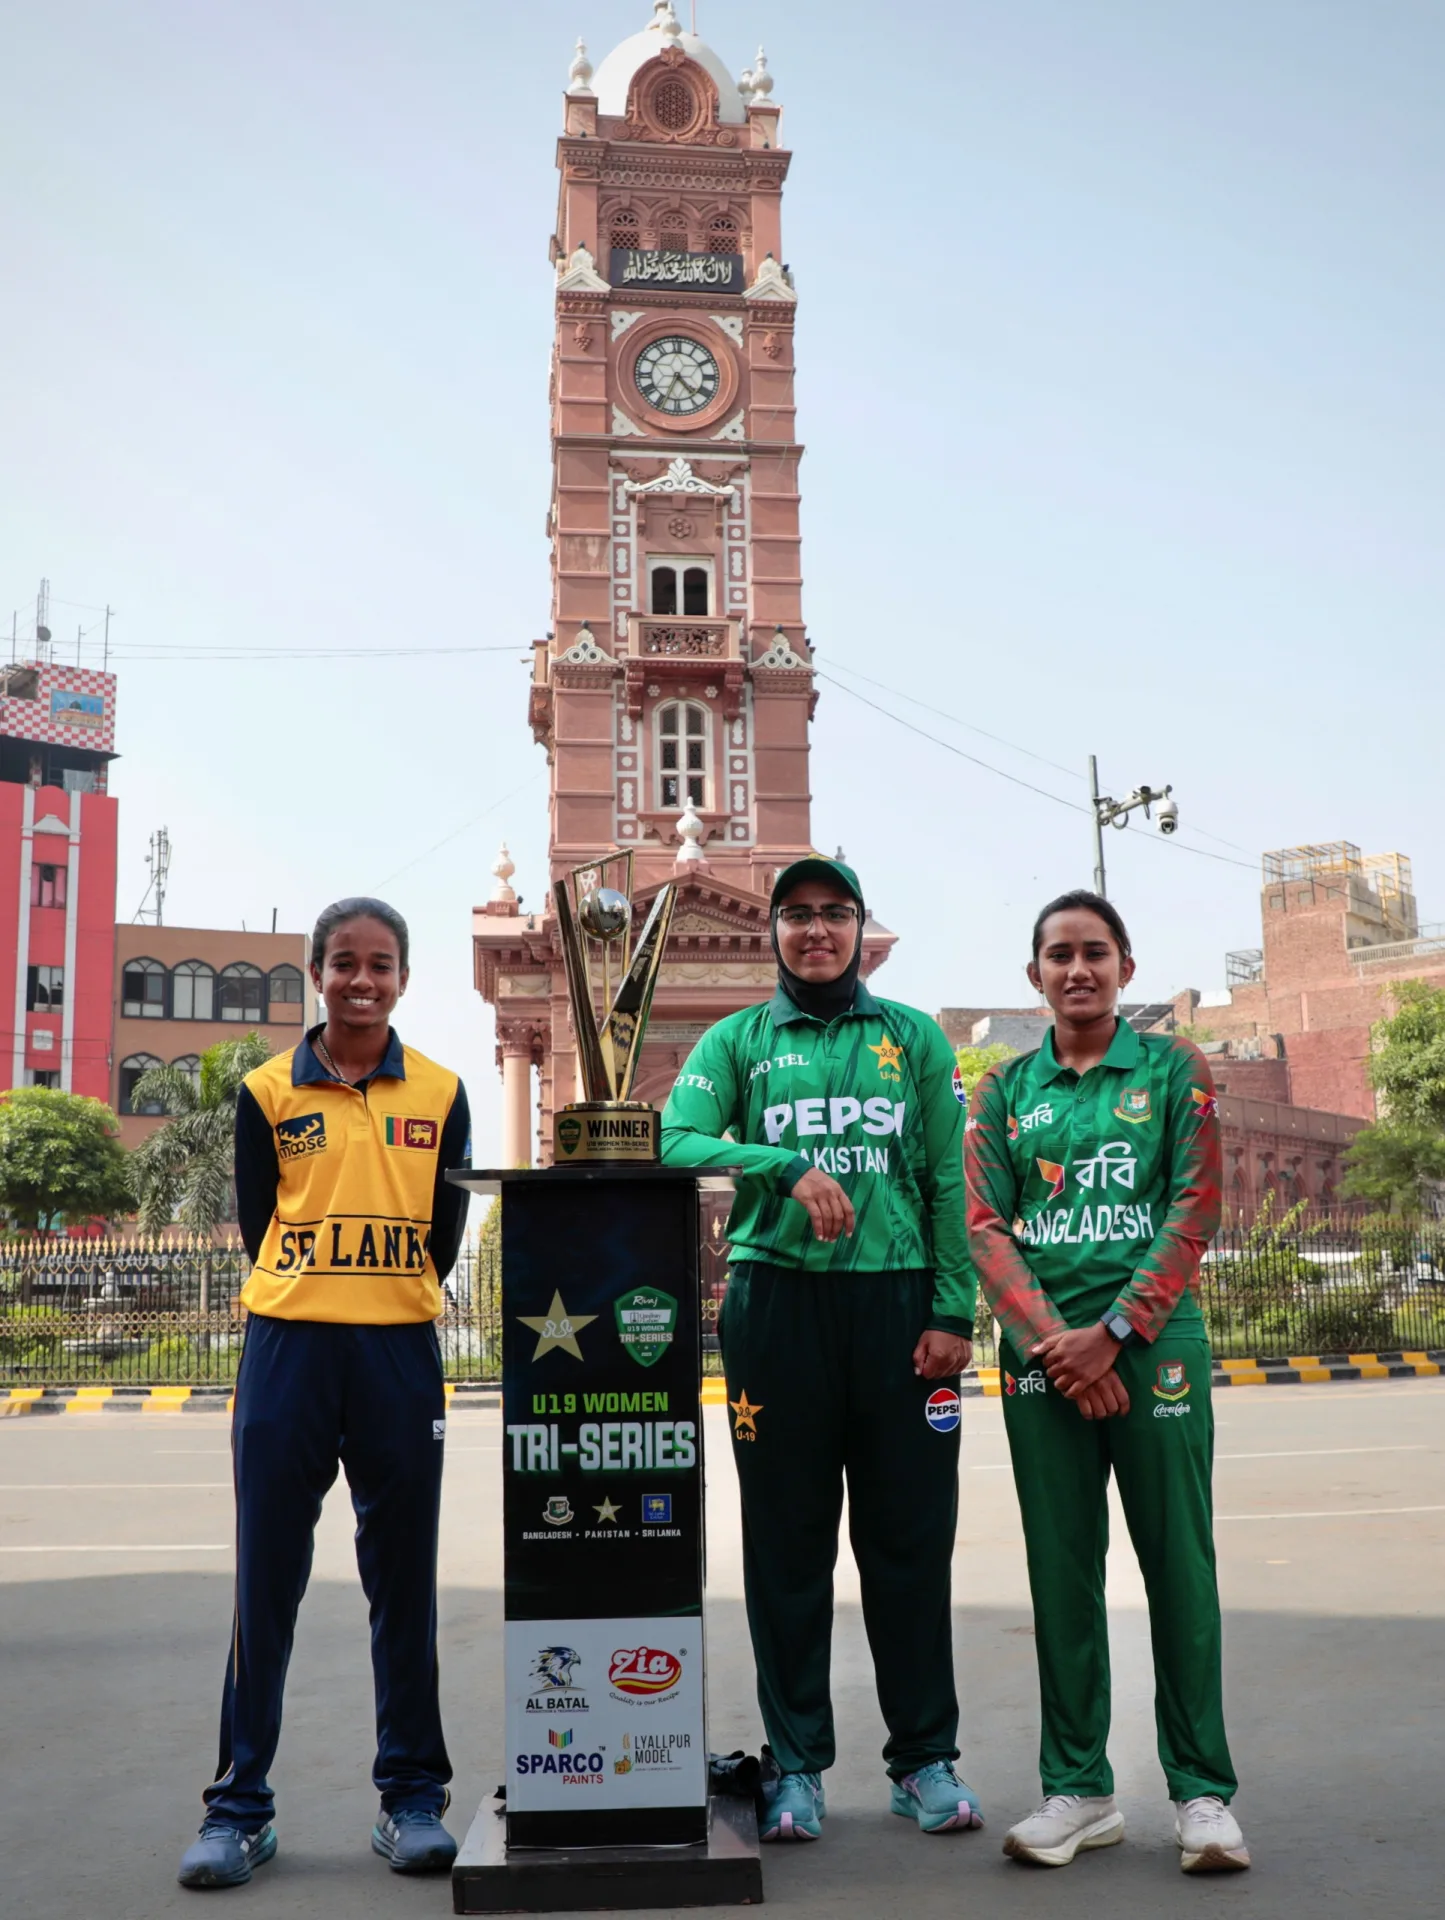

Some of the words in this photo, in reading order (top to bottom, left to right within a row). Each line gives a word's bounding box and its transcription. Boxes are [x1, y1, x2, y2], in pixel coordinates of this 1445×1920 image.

[774, 1053, 810, 1069] TEL
[687, 1074, 716, 1096] TEL
[763, 1096, 905, 1144] PEPSI
[1019, 1102, 1054, 1133] রবি
[587, 1119, 650, 1138] WINNER
[278, 1135, 328, 1160] moose
[800, 1145, 889, 1175] KISTAN
[1072, 1141, 1138, 1195] রবি
[1021, 1202, 1155, 1246] ANGLADESH
[618, 1333, 674, 1344] TRI-SERIES
[1018, 1369, 1047, 1396] রবি
[533, 1394, 576, 1414] U19
[583, 1392, 669, 1413] WOMEN
[927, 1404, 960, 1416] PEPSI
[506, 1421, 696, 1471] TRI-SERIES
[736, 1429, 756, 1442] U-19
[522, 1531, 572, 1540] BANGLADESH
[584, 1529, 630, 1539] PAKISTAN
[642, 1529, 655, 1538] SRI
[656, 1528, 682, 1538] LANKA
[611, 1648, 675, 1682] Zia
[525, 1698, 543, 1709] AL
[547, 1697, 590, 1709] BATAL
[634, 1733, 691, 1749] LYALLPUR
[516, 1753, 604, 1774] SPARCO
[634, 1749, 673, 1764] MODEL
[562, 1774, 604, 1785] PAINTS
